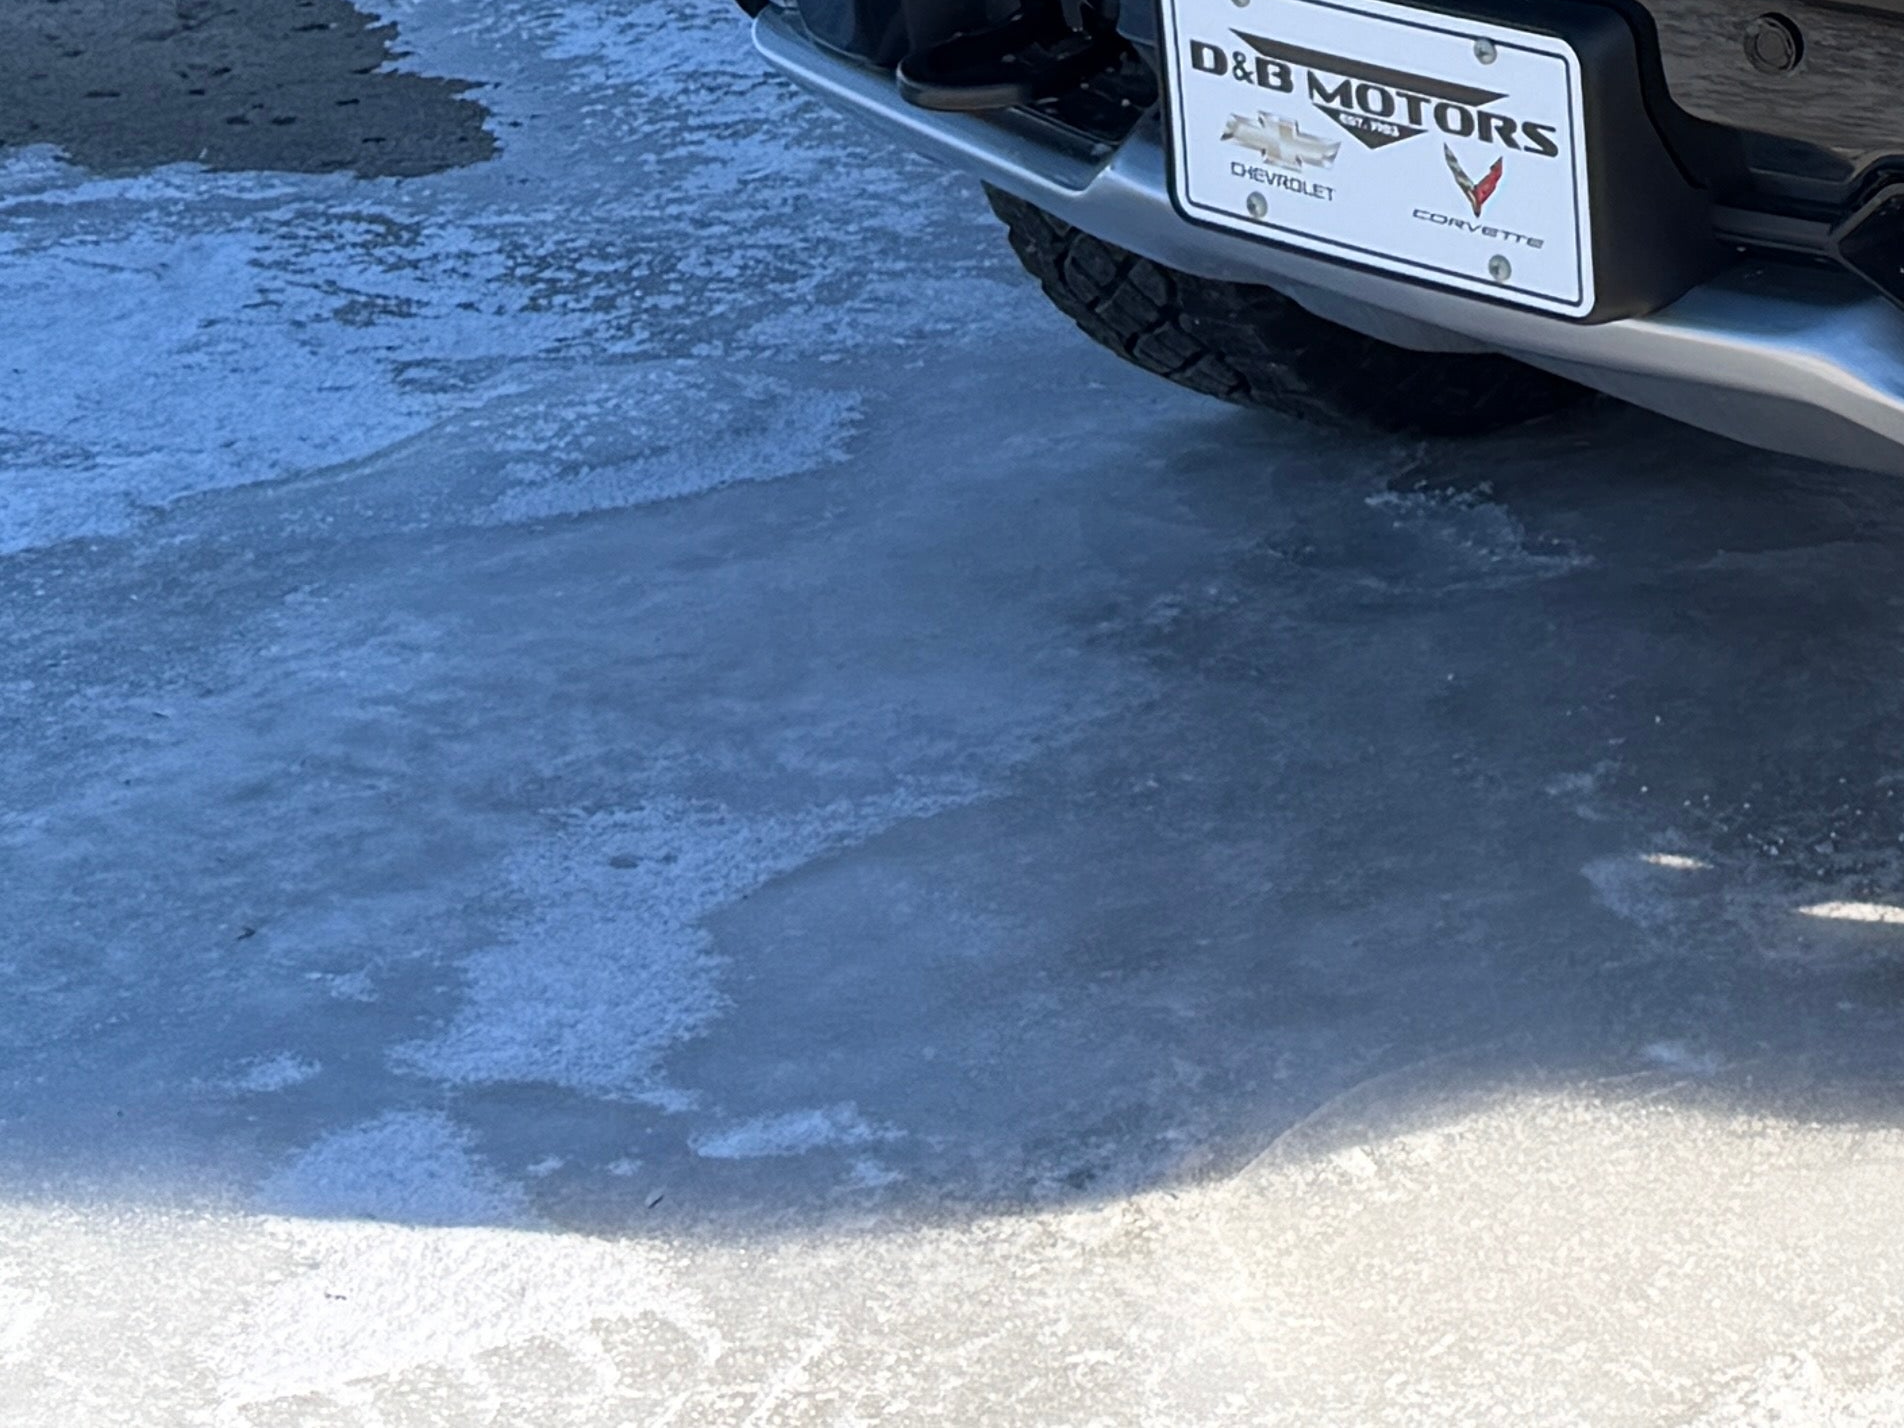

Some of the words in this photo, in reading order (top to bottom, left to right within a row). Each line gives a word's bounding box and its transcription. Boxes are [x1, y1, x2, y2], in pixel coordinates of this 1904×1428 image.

[1189, 38, 1294, 95] D&B
[1306, 69, 1560, 158] MOTORS
[1230, 159, 1337, 203] CHEVROLET
[1411, 208, 1545, 250] CORVETTE
